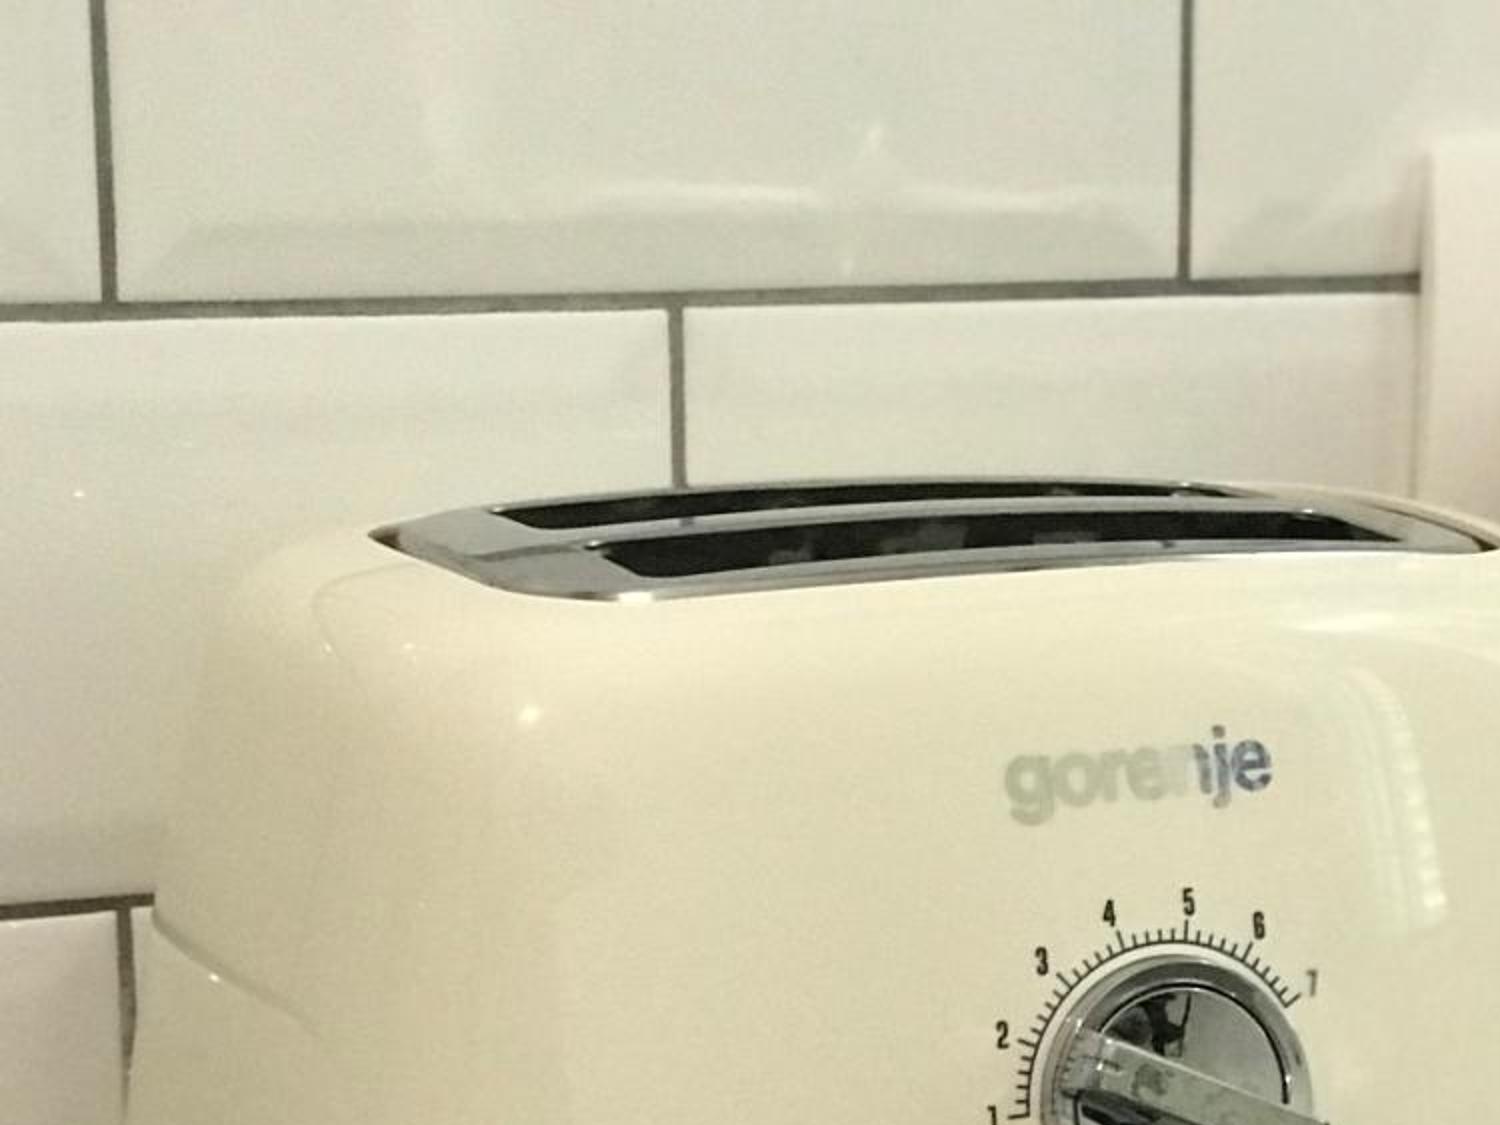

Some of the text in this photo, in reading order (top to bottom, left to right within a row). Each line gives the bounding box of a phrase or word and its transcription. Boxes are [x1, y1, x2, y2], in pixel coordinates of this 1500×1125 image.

[1005, 724, 1272, 827] gorenje
[1102, 900, 1116, 927] 4
[1182, 888, 1195, 917] 5
[1252, 911, 1266, 940] 6
[1035, 946, 1049, 976] 3
[996, 1021, 1010, 1050] 2
